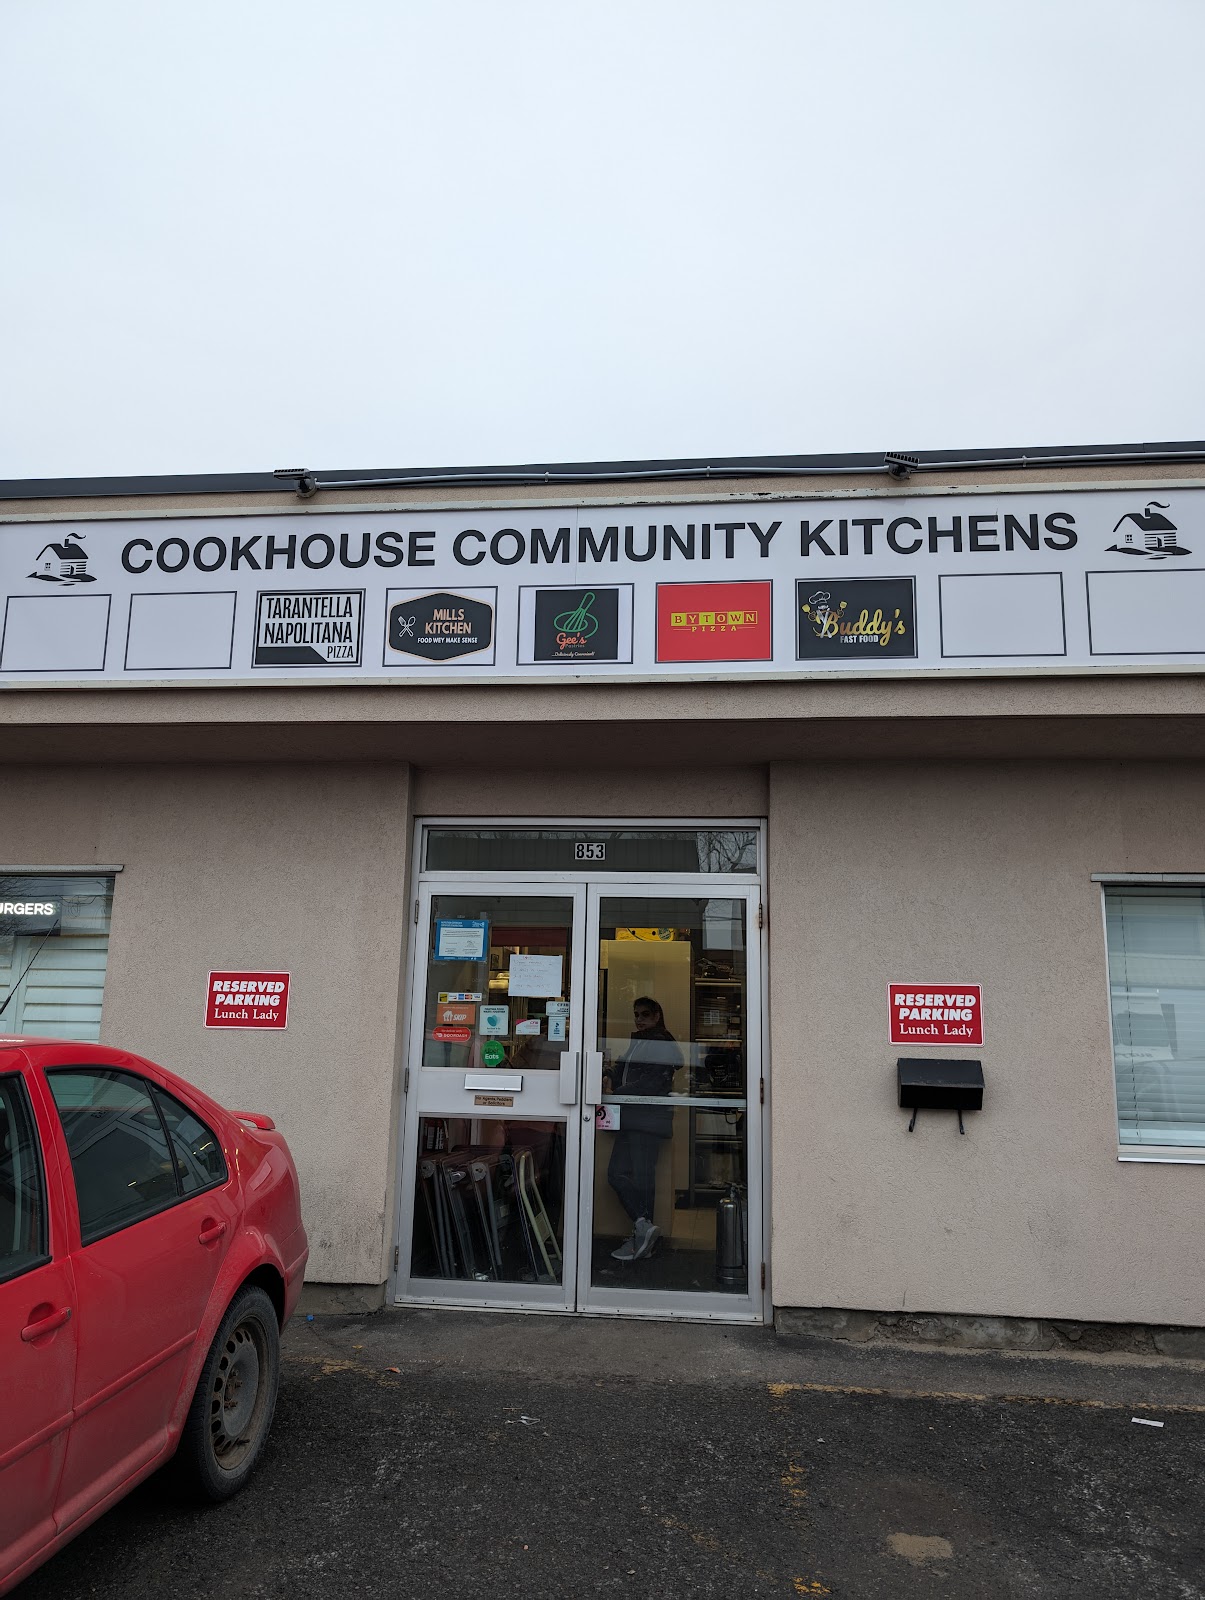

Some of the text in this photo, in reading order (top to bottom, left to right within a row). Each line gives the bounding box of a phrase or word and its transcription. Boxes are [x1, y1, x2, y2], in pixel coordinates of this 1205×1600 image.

[121, 512, 1078, 573] COOKHOUSE COMMUNITY KITCHENS
[266, 596, 353, 619] TARANTELLA
[433, 608, 465, 621] MILLS
[674, 613, 755, 624] BYTOWN
[263, 621, 353, 644] NAPOLITANA
[425, 622, 472, 635] KITCHEN
[813, 608, 906, 647] Buddy's
[556, 632, 587, 650] Gee's
[840, 635, 879, 643] FAST FOOD
[326, 645, 354, 659] PIZZA
[576, 843, 604, 859] 853
[212, 980, 285, 993] RESERVED
[214, 993, 281, 1006] PARKING
[894, 993, 977, 1007] RESERVED
[213, 1007, 279, 1021] Lunch Lady
[899, 1008, 973, 1021] PARKING
[899, 1023, 973, 1037] Lunch Lady
